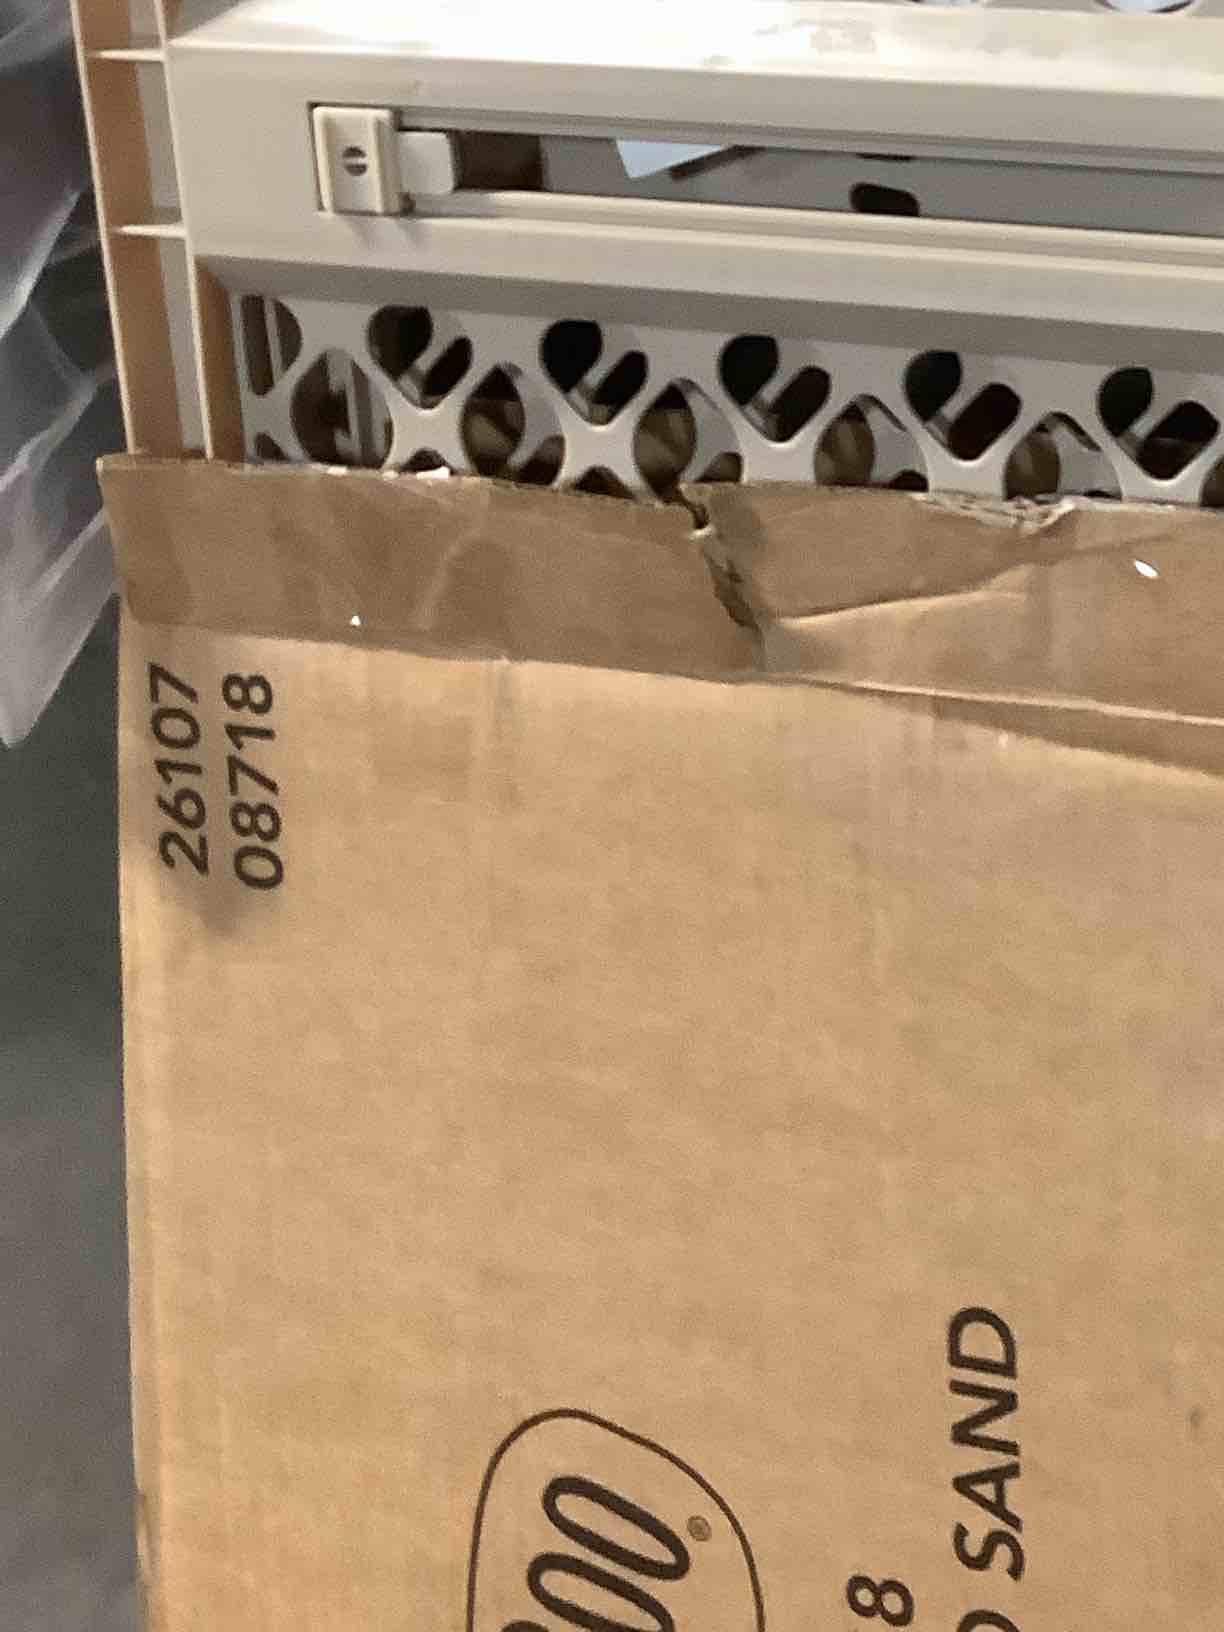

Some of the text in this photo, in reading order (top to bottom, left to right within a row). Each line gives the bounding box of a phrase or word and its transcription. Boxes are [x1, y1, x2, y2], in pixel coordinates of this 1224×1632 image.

[148, 661, 208, 876] 26107
[222, 673, 284, 891] 08718
[946, 1305, 1025, 1582] SAND
